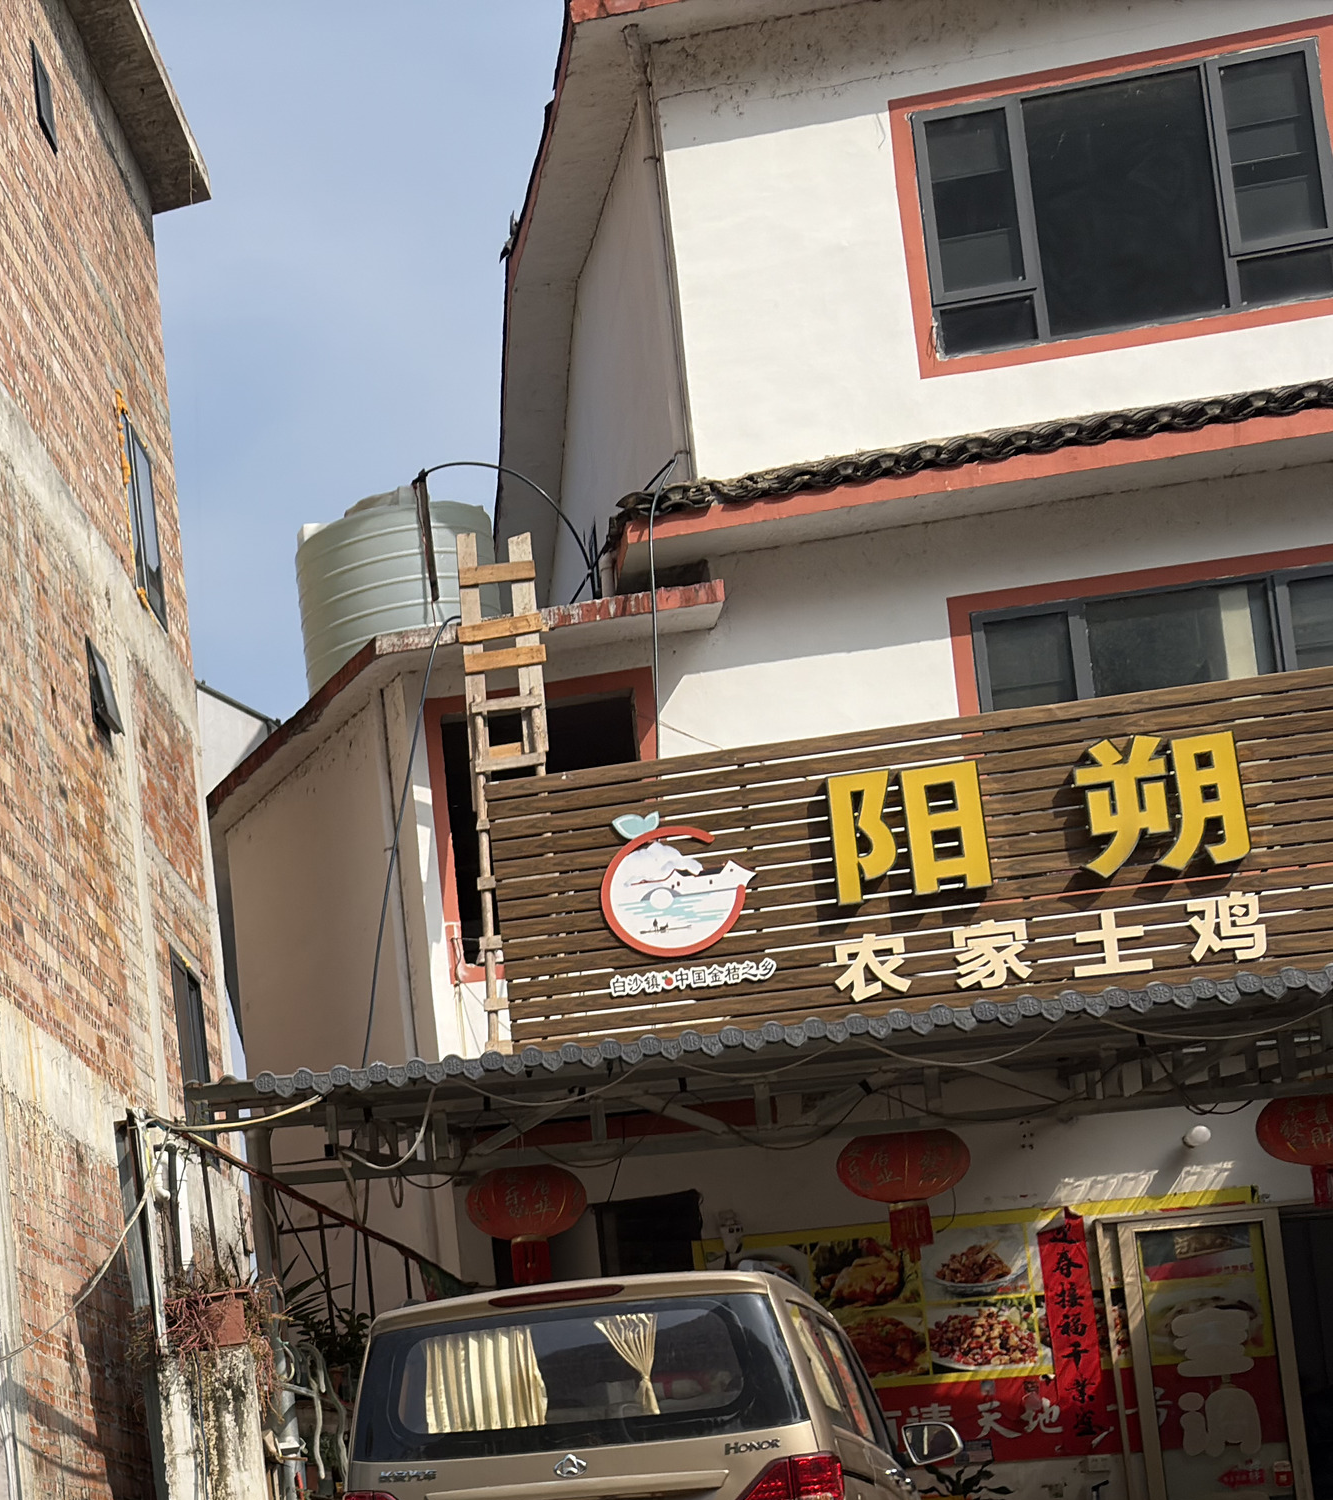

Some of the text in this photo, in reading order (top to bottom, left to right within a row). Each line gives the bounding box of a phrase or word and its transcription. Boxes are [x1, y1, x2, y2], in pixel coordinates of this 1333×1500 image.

[826, 729, 1254, 906] 阳朔
[834, 890, 1269, 1002] 农家土鸡
[609, 972, 662, 997] 白沙镇
[724, 1437, 781, 1456] HONOR
